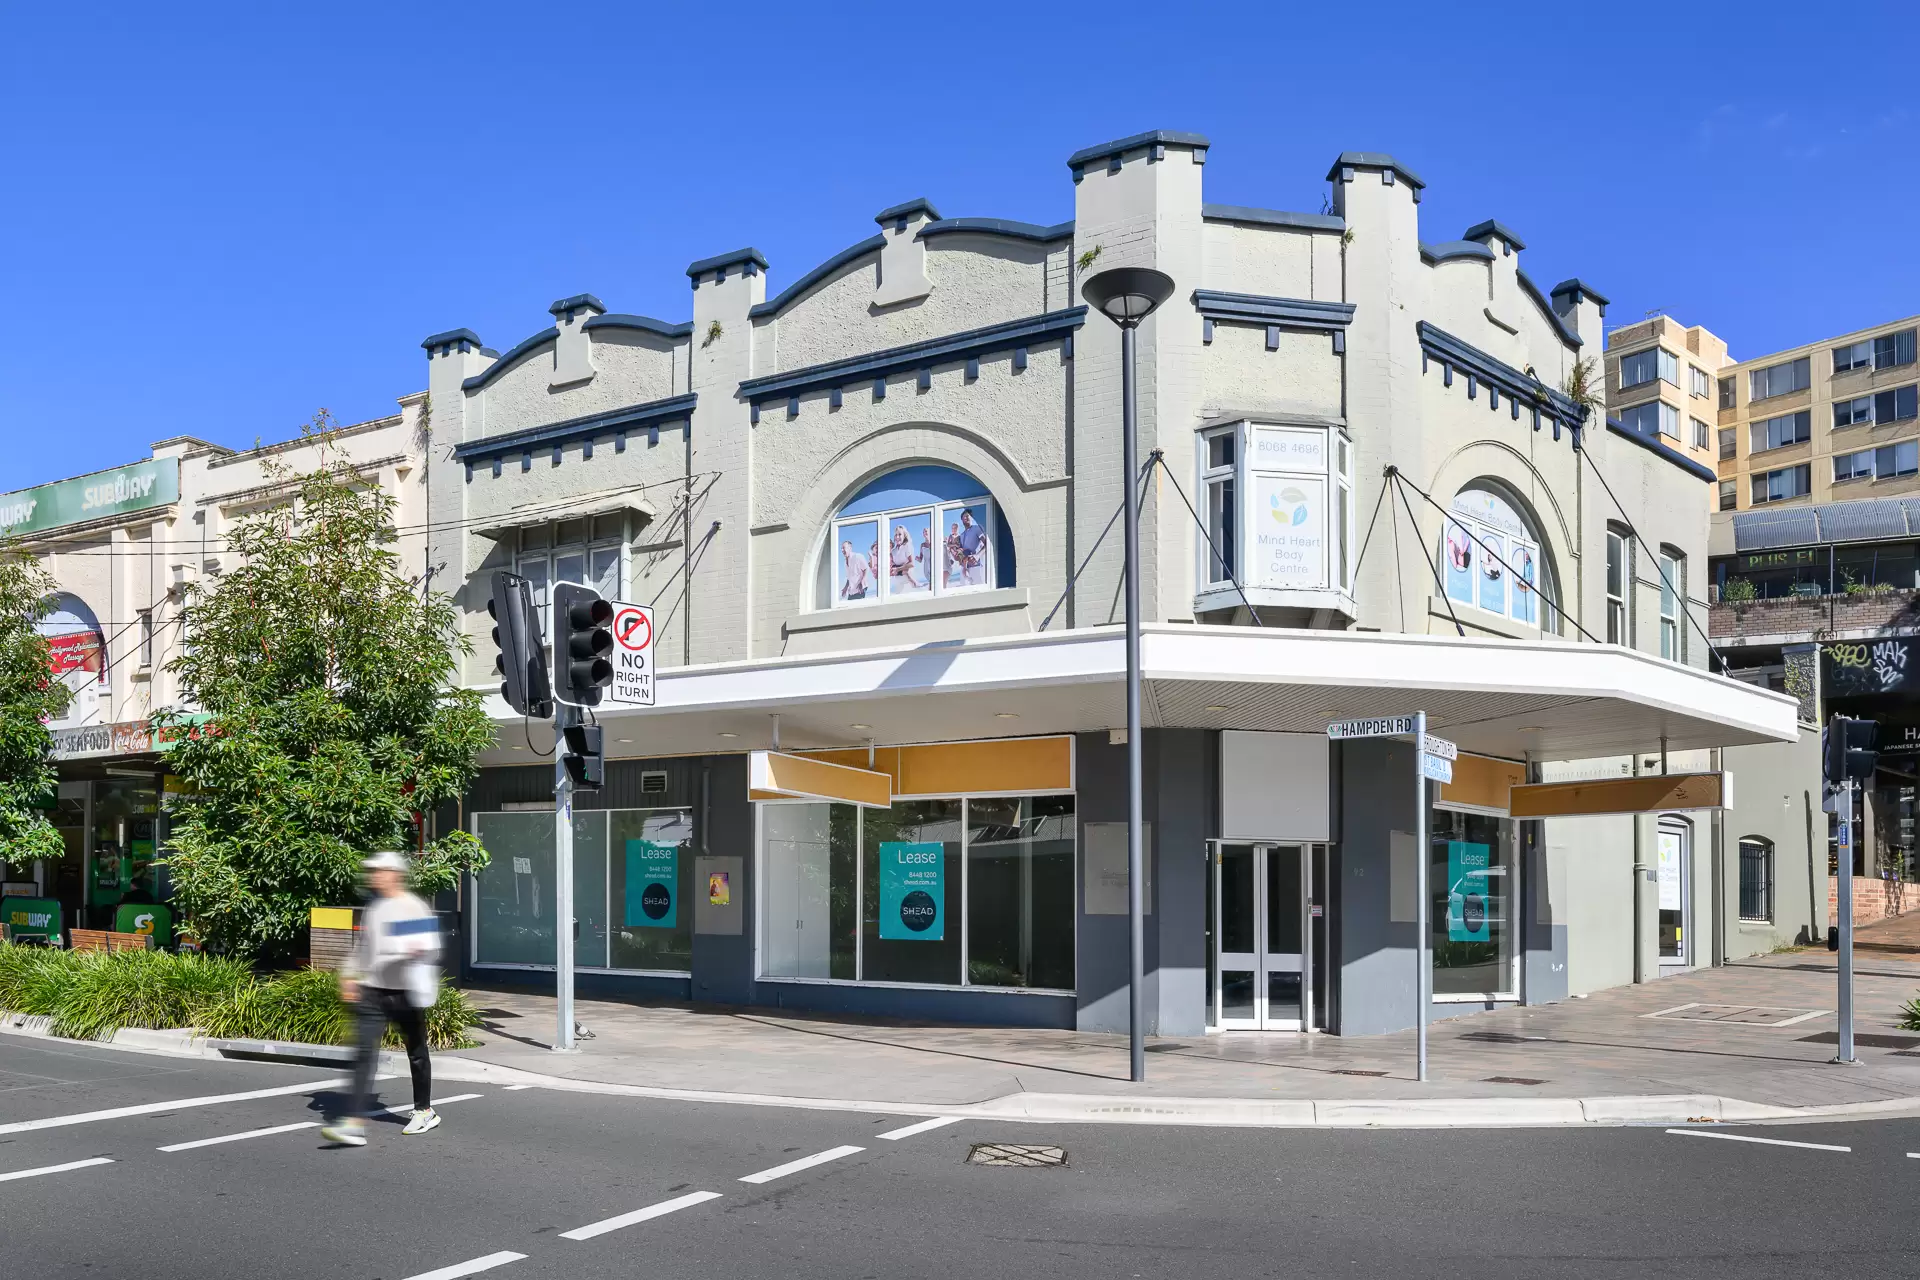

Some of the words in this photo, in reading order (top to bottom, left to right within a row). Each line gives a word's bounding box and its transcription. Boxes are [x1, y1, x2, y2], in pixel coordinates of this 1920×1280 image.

[1258, 441, 1287, 453] 8068
[1291, 443, 1320, 454] 4696
[81, 472, 156, 511] SUBWAY
[1258, 534, 1286, 546] Mind
[1290, 536, 1320, 548] Heart
[1275, 549, 1304, 562] Body
[1270, 562, 1309, 574] Centre
[63, 654, 84, 664] Massage
[621, 652, 645, 669] NO
[616, 671, 650, 685] RIGHT
[618, 685, 649, 699] TURN
[1341, 719, 1394, 737] HAMPDEN
[1396, 718, 1412, 733] RD
[65, 731, 110, 752] SEAFOOD
[1884, 743, 1914, 751] JAPANESE
[641, 846, 672, 859] Lease
[898, 849, 937, 864] Lease
[1460, 851, 1484, 866] Lease
[644, 898, 669, 906] SHEAD
[903, 907, 934, 916] SHEAD
[1464, 908, 1483, 917] SHEAD
[10, 911, 52, 929] SUBWAY
